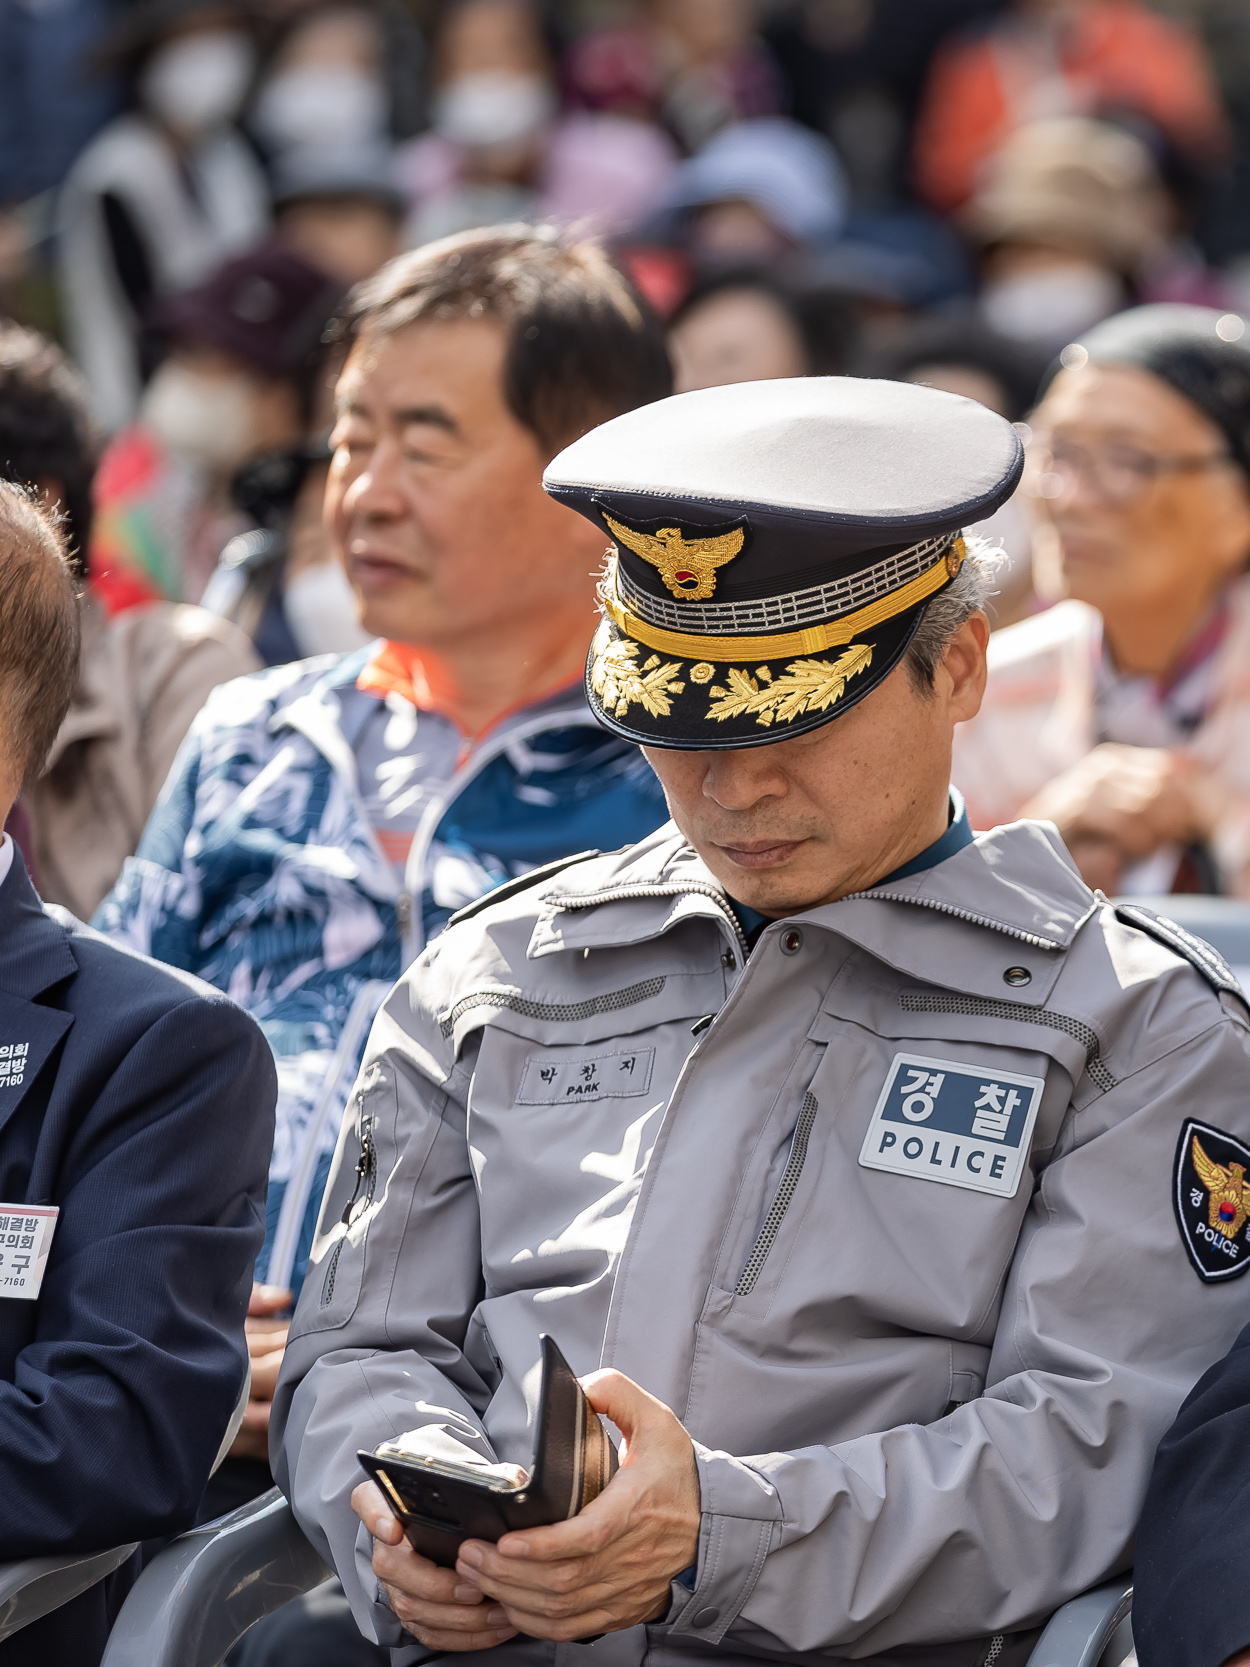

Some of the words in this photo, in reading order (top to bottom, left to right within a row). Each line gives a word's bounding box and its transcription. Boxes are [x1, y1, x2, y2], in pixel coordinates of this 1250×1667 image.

[566, 1082, 600, 1096] PARK
[878, 1131, 1007, 1179] POLICE
[1195, 1222, 1239, 1258] POLICE
